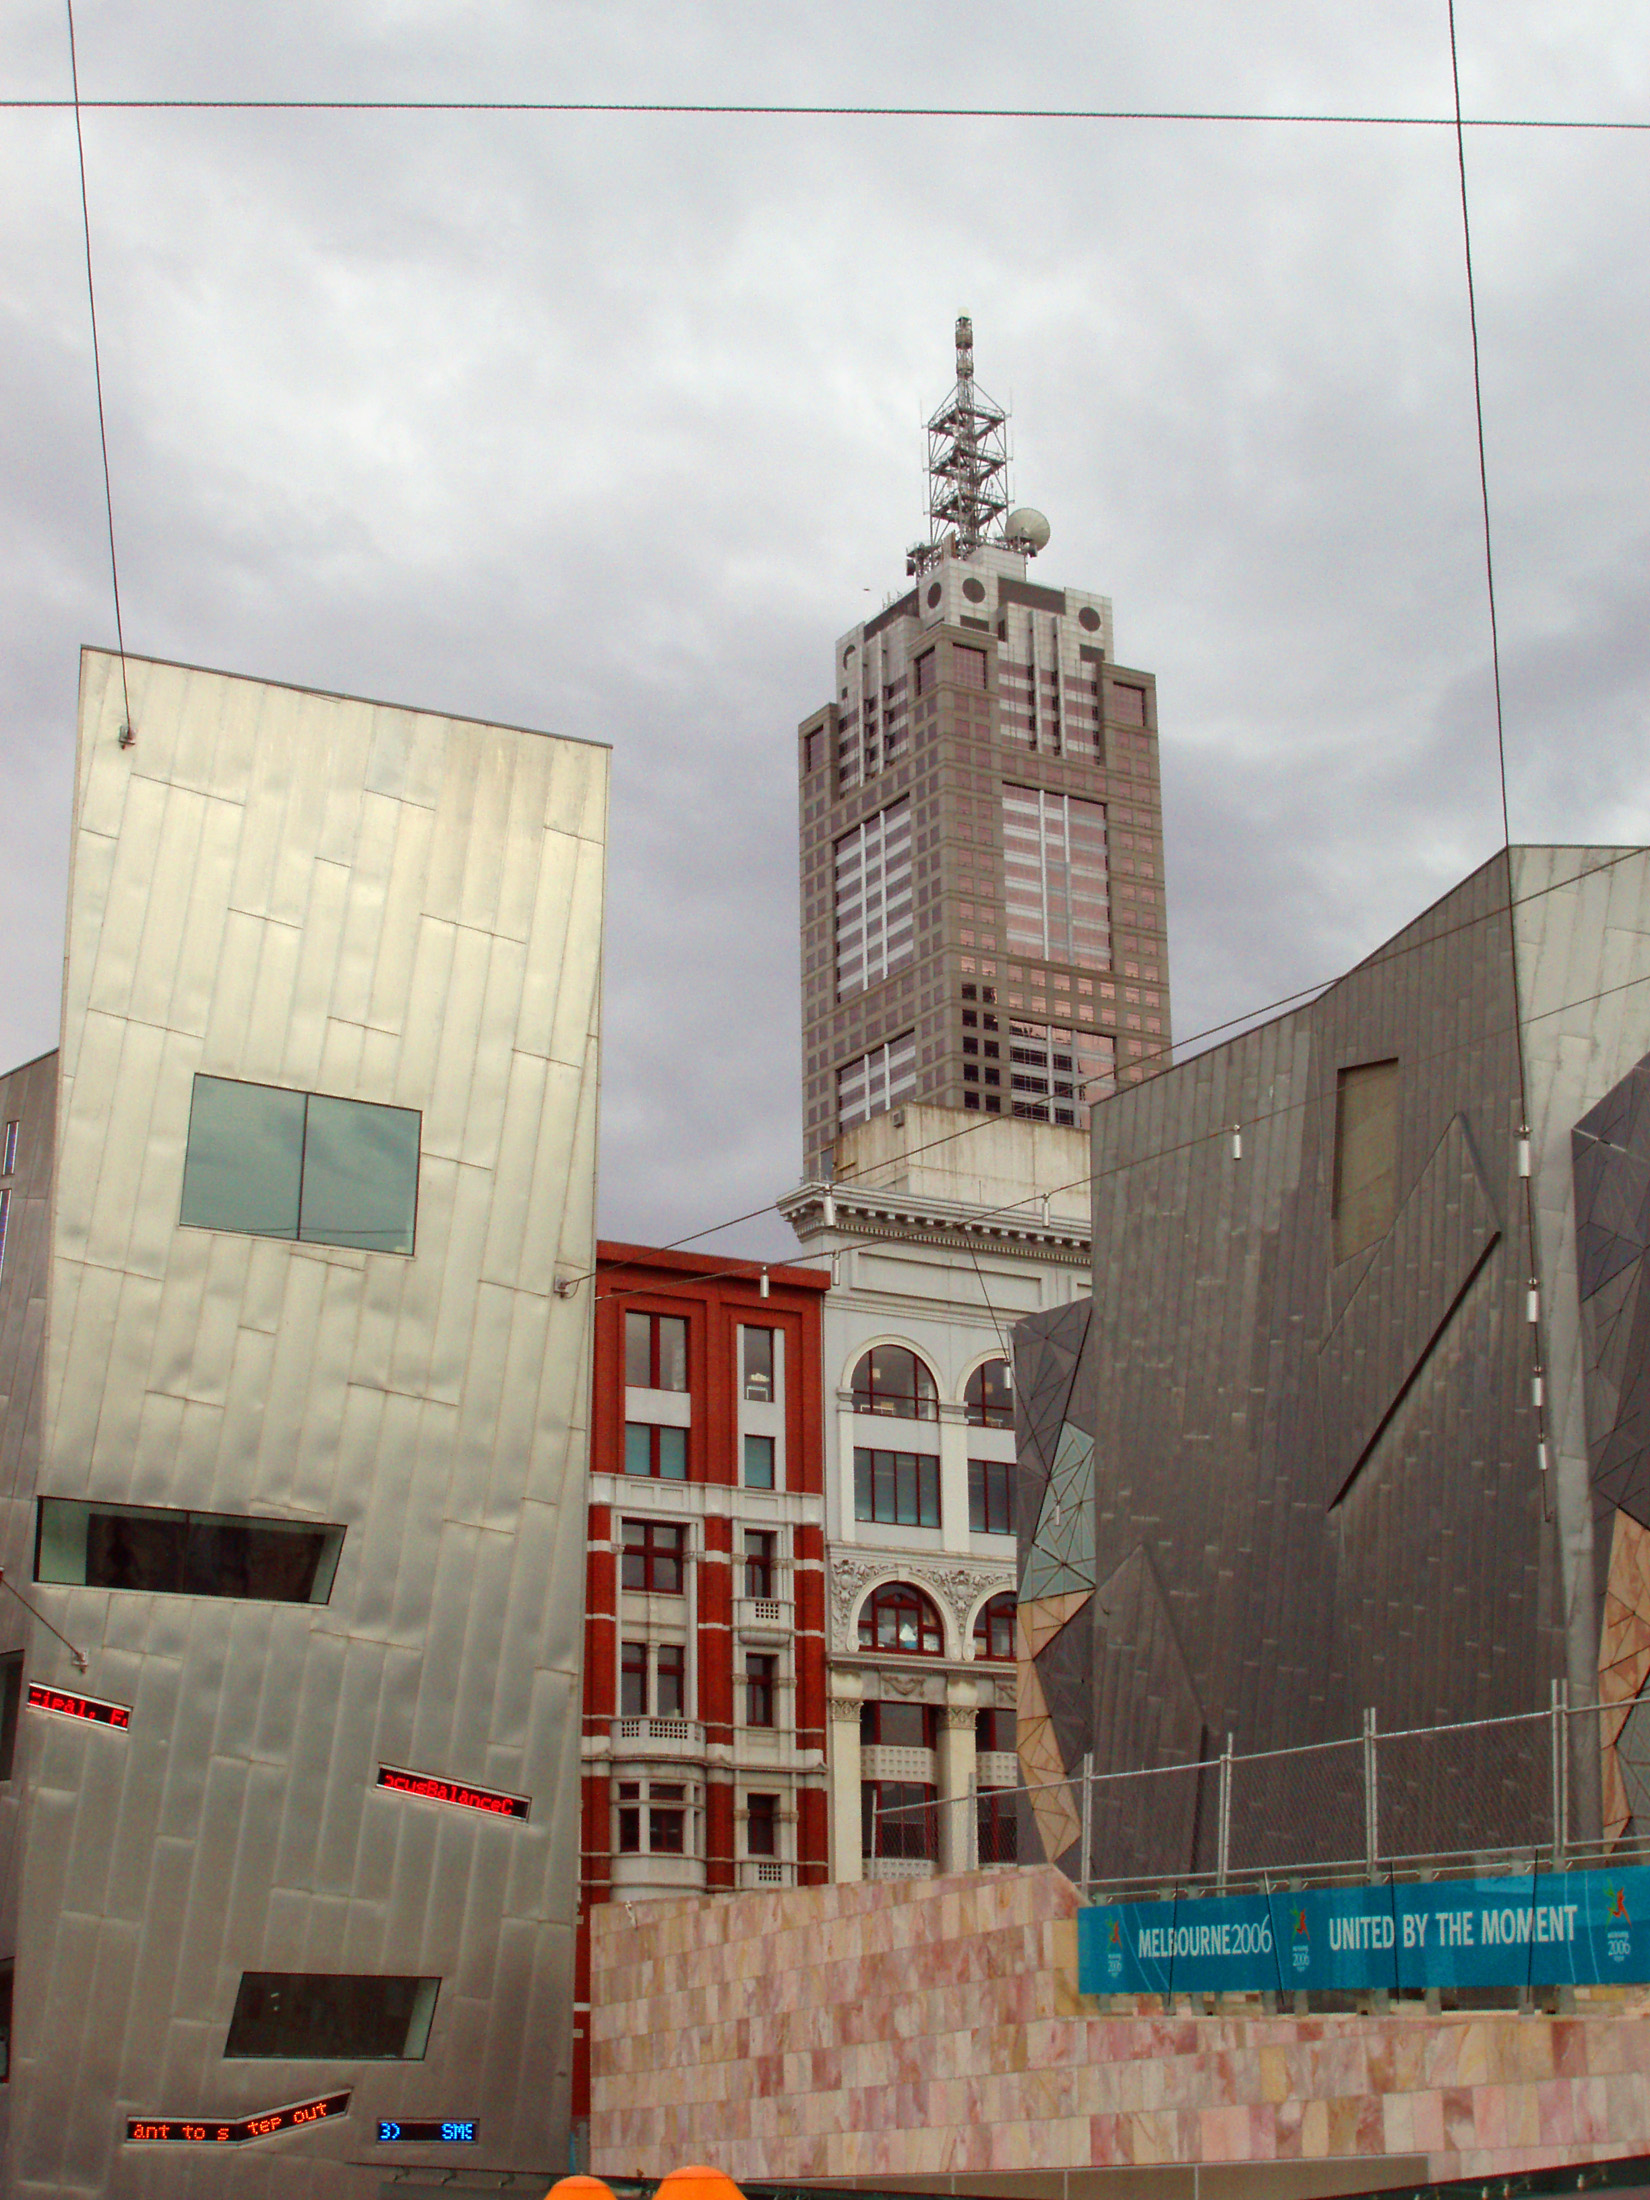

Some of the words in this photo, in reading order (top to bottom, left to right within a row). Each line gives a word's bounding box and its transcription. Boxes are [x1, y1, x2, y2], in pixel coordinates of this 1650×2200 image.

[1329, 1915, 1395, 1951] UNITED
[1403, 1912, 1429, 1948] BY
[1435, 1911, 1474, 1947] THE
[1481, 1904, 1578, 1945] MOMENT
[1607, 1936, 1631, 1957] 2006
[134, 2123, 170, 2140] ant
[182, 2124, 206, 2140] to
[292, 2101, 327, 2123] out
